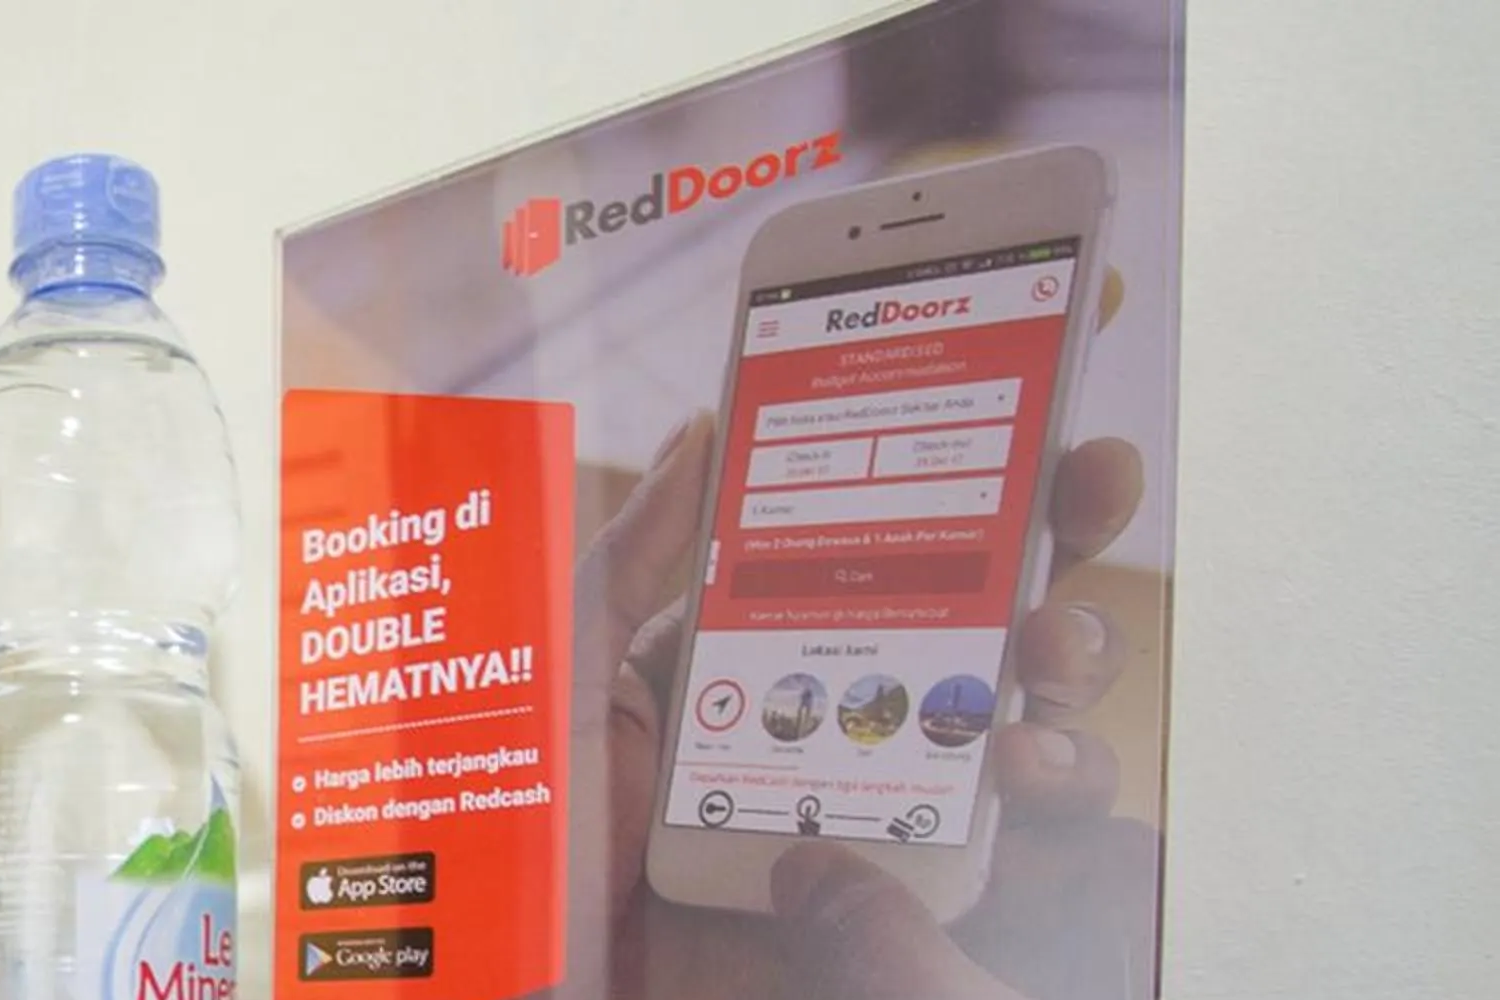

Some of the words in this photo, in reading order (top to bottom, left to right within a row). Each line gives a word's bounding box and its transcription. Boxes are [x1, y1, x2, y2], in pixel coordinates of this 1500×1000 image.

[565, 130, 842, 245] RedDoorz
[825, 295, 972, 333] RedDoorz
[302, 509, 447, 563] Booking
[456, 489, 491, 530] di
[301, 554, 451, 617] Aplikasi,
[301, 607, 446, 665] DOUBLE
[300, 646, 533, 715] HEMATNYA!!
[314, 766, 371, 790] Harga
[375, 758, 423, 782] lebih
[428, 746, 539, 777] terjangkau
[314, 806, 378, 826] Diskon
[382, 797, 455, 821] dengan
[460, 784, 550, 811] Redcash
[338, 878, 376, 901] App
[378, 874, 427, 895] Store
[336, 947, 393, 972] Google
[396, 945, 429, 968] play
